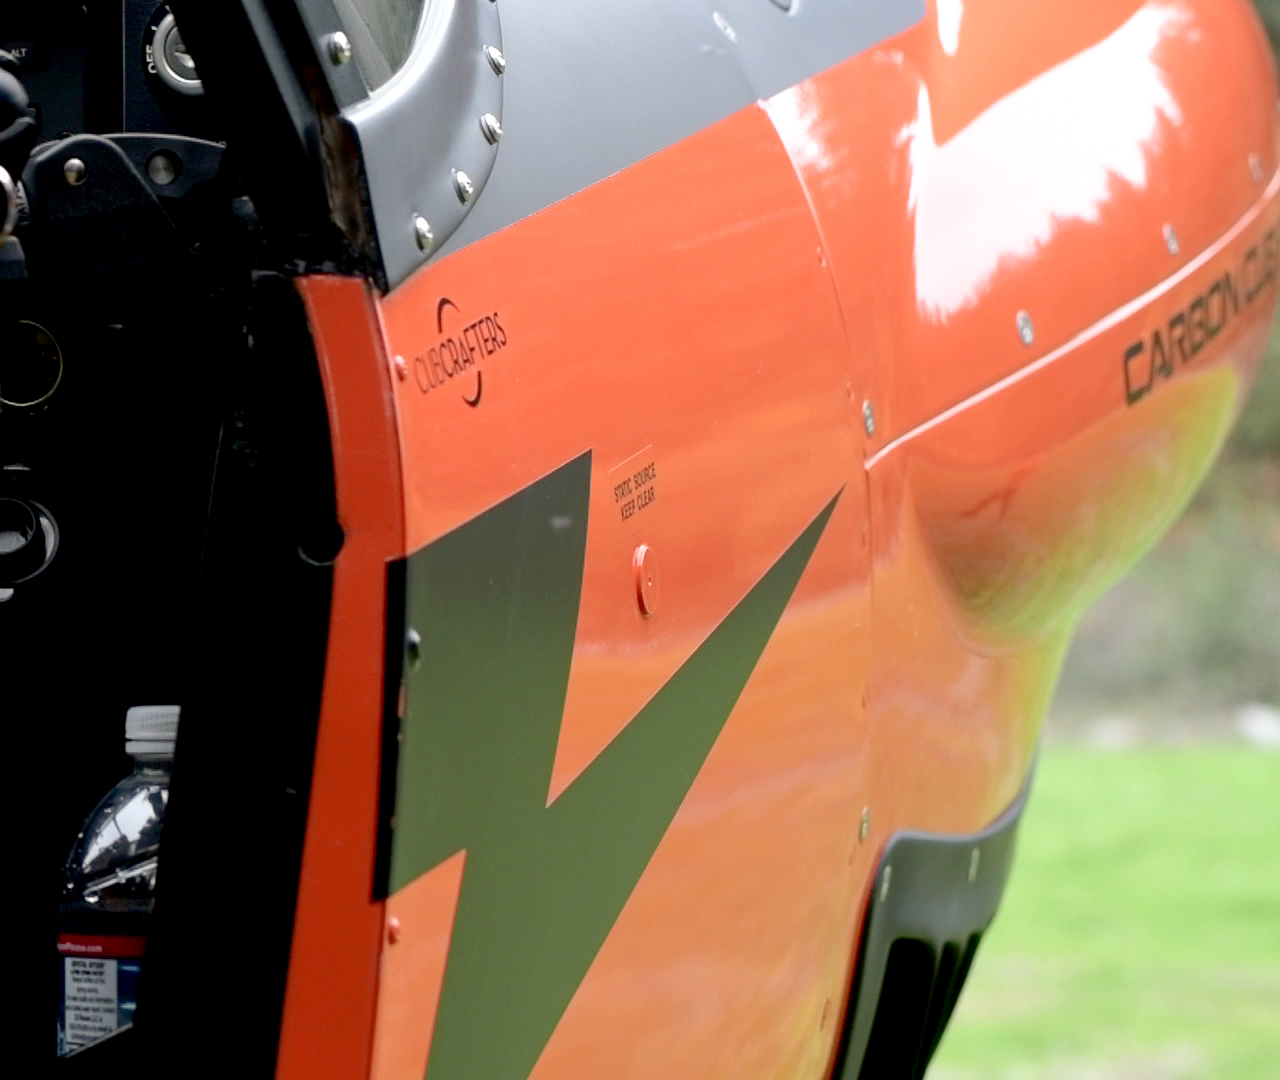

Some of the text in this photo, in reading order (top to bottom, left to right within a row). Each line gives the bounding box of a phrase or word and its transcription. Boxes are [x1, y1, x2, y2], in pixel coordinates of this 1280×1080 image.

[413, 311, 507, 395] CUBCRAFTERS
[1124, 273, 1239, 407] CARBON
[614, 461, 657, 503] STATIC SOURCE
[620, 485, 655, 522] KEEP CLEAR
